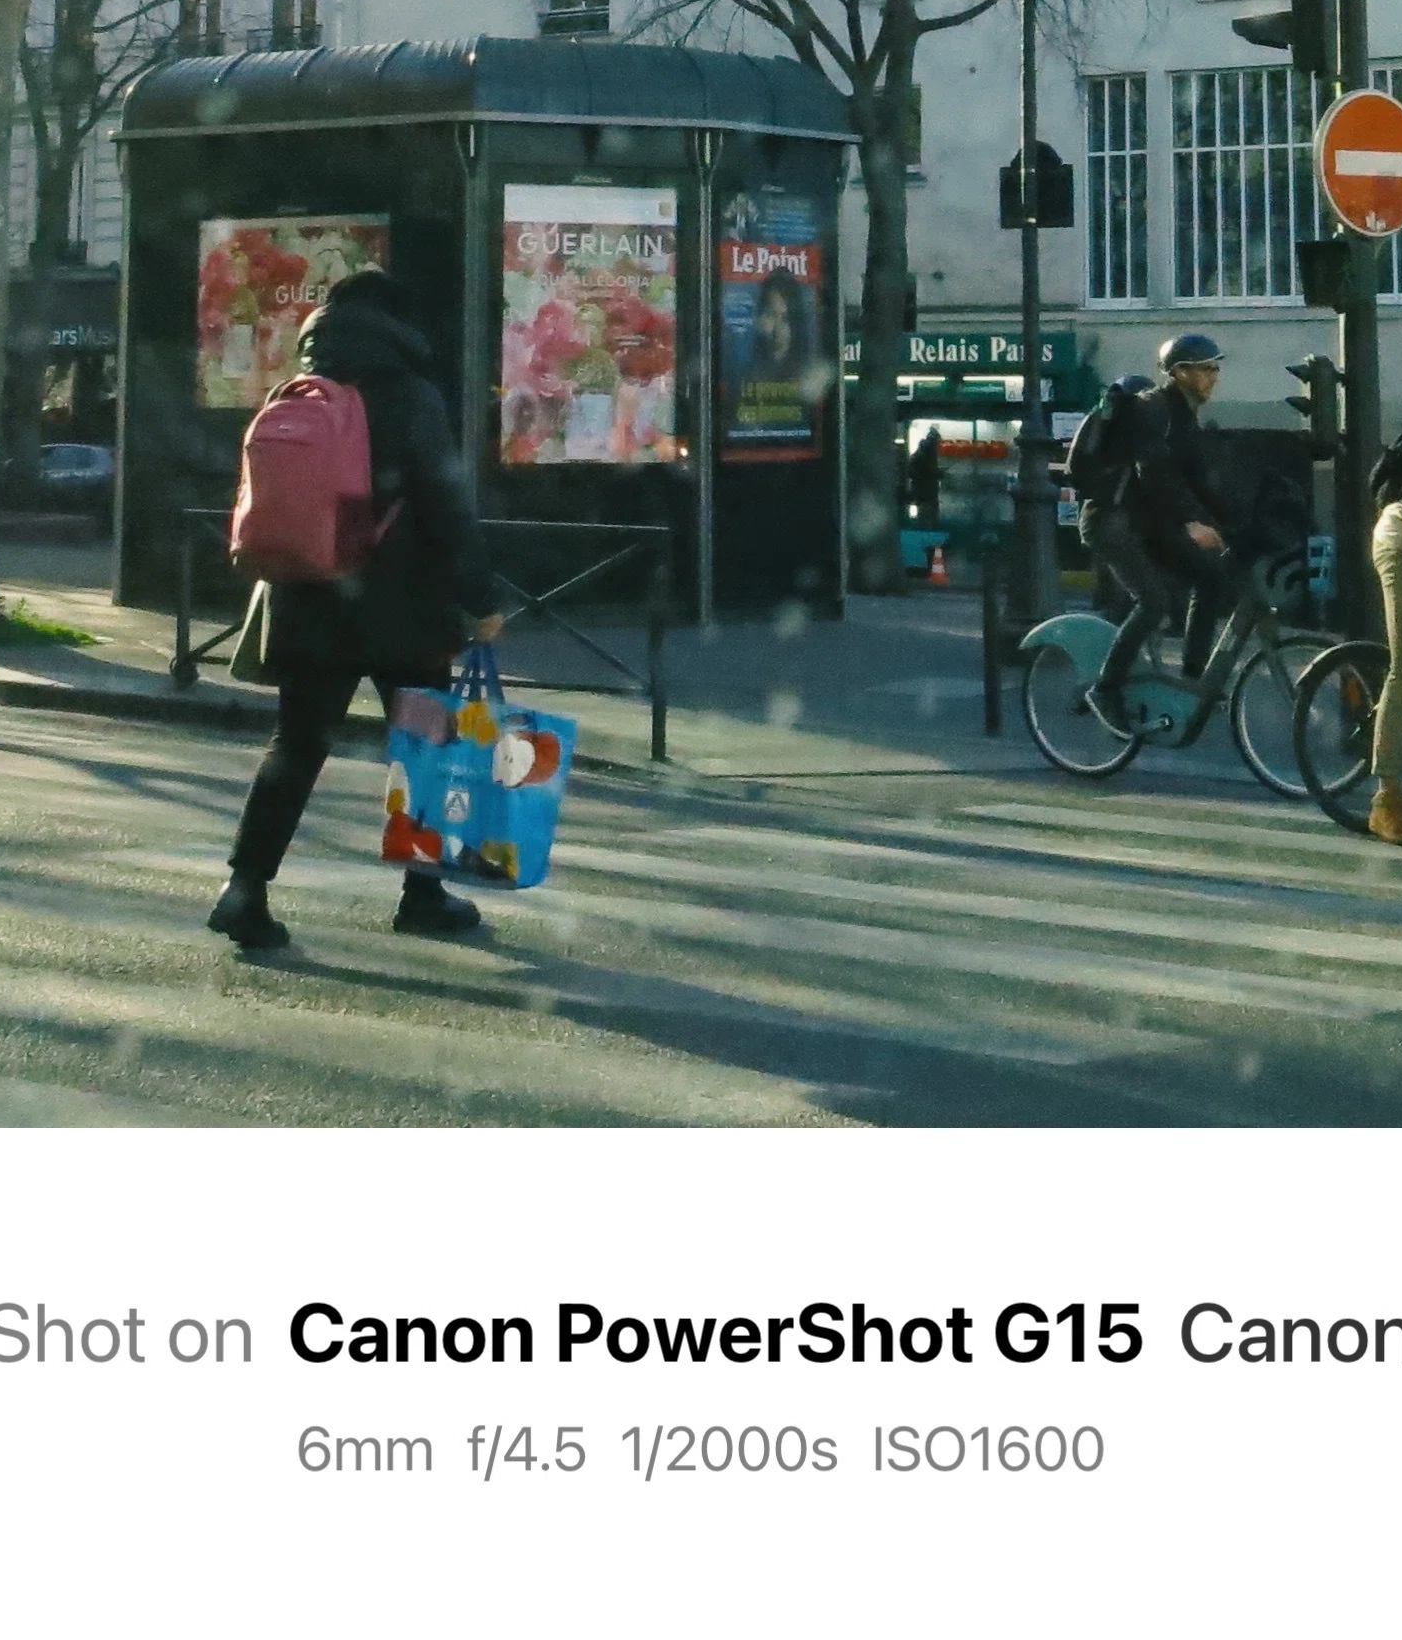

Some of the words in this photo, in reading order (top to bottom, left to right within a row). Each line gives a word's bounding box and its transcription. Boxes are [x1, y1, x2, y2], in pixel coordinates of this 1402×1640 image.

[517, 231, 664, 257] GUERLAIN
[731, 245, 755, 273] Le
[756, 245, 808, 276] Point
[275, 284, 330, 306] GUER
[909, 336, 980, 364] Relais
[990, 336, 1054, 363] Pas
